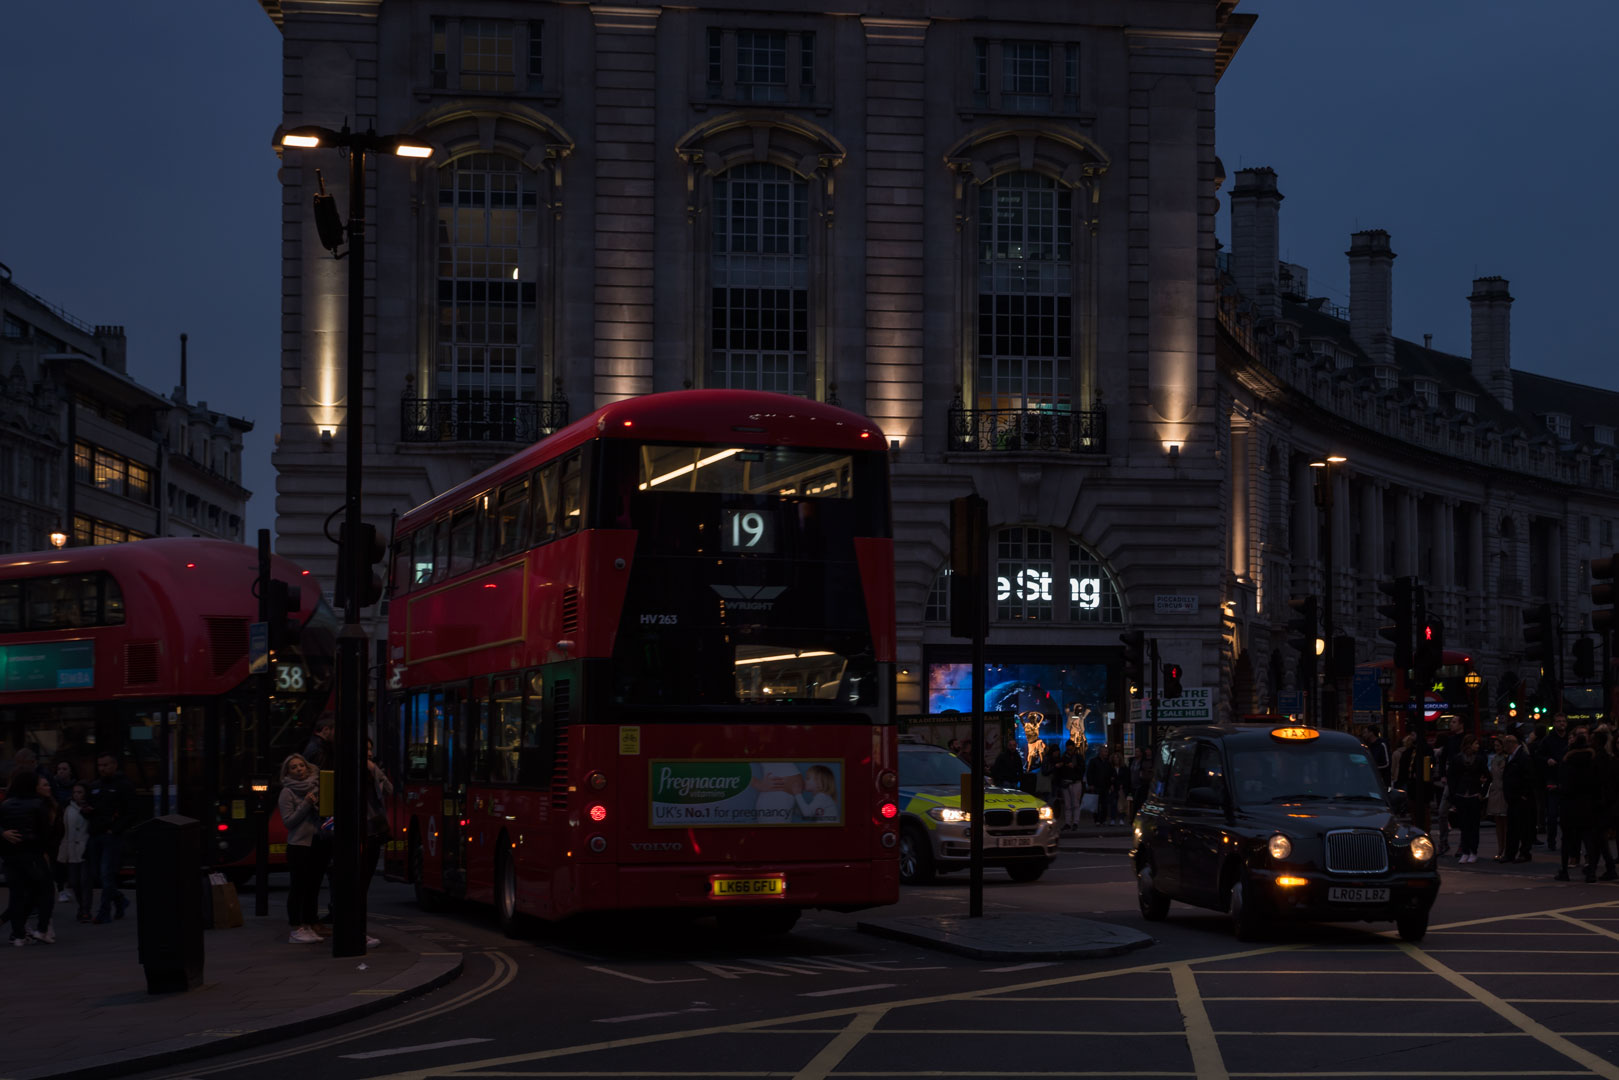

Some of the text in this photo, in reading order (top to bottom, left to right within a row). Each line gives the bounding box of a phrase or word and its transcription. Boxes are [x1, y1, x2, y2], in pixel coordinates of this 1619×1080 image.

[732, 512, 764, 547] 19
[1016, 568, 1101, 611] Stng
[726, 602, 775, 611] WRIGHT
[640, 614, 678, 625] HV 263
[276, 665, 304, 689] 38
[1146, 689, 1209, 699] THTRE
[1149, 699, 1206, 708] ICKETS
[657, 767, 741, 797] Pregnacare
[655, 807, 682, 819] UK's
[685, 807, 710, 818] No.1
[714, 806, 730, 818] for
[732, 807, 792, 821] pregnancy
[631, 842, 683, 851] VOLVO
[719, 880, 776, 893] LK66 GFU
[1333, 888, 1362, 900] LR05
